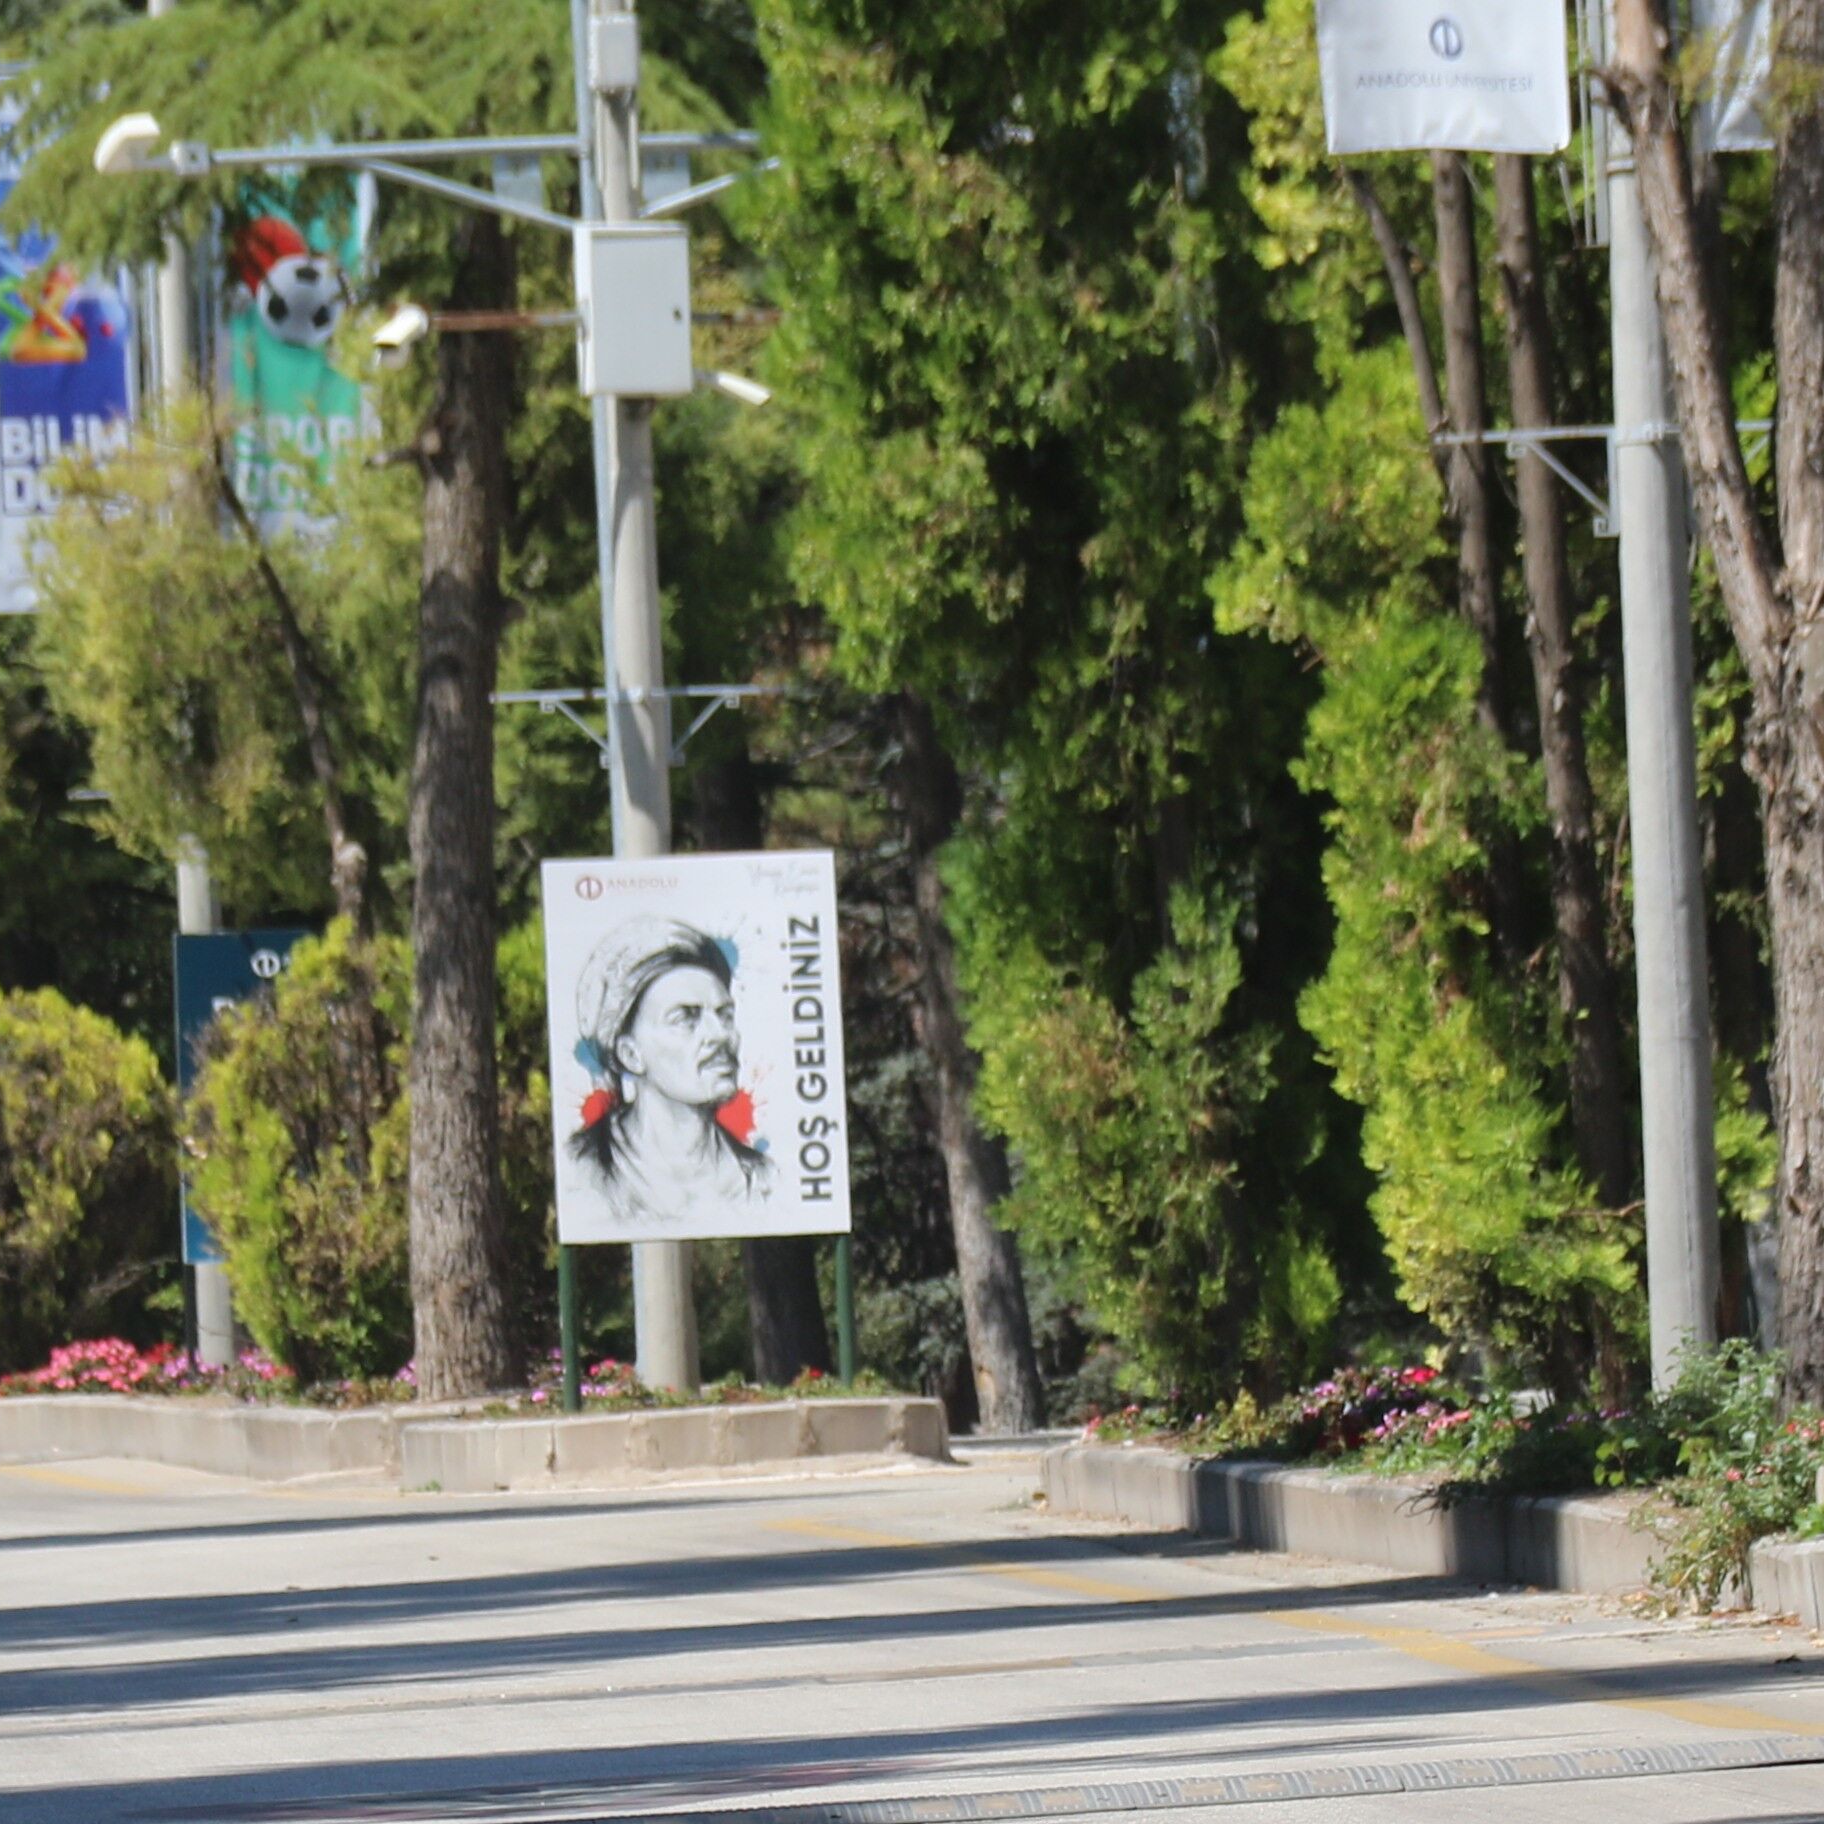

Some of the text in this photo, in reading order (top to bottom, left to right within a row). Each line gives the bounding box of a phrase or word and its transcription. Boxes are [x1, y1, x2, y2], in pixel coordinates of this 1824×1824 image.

[607, 877, 679, 890] ANADOLU
[780, 915, 828, 1104] GELDİNİZ
[798, 1115, 838, 1202] HOŞ
